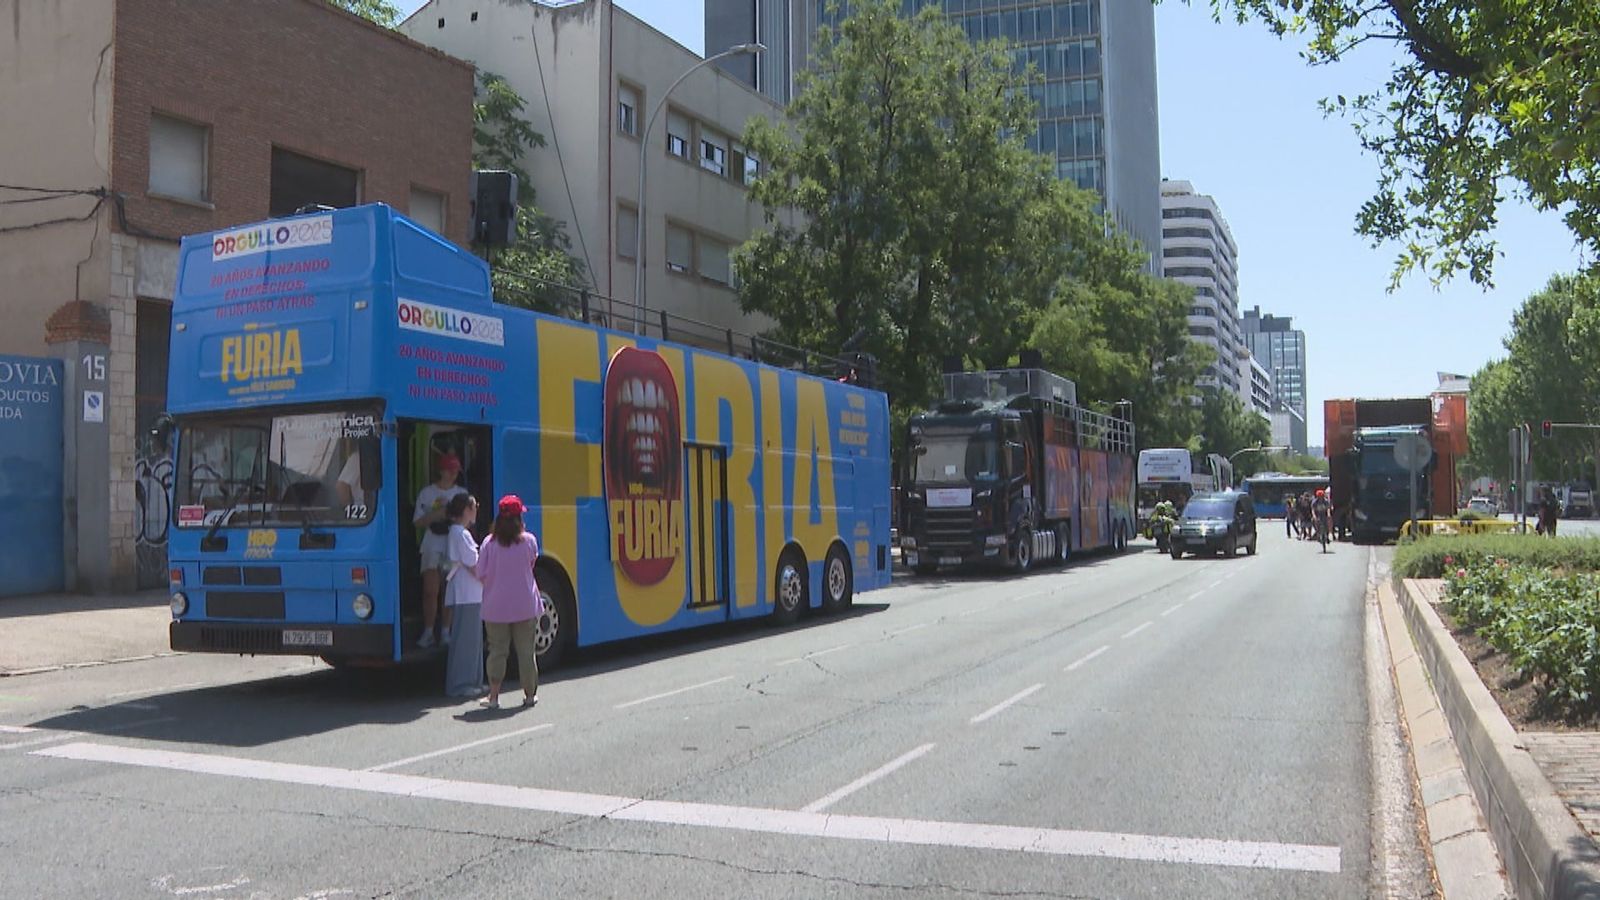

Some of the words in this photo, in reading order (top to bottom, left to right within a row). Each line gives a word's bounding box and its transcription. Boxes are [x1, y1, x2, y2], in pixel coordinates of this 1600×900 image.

[213, 220, 332, 256] ORGULLO2025
[255, 257, 330, 277] AVANZANDO
[224, 288, 239, 301] EN
[216, 305, 226, 319] NI
[228, 302, 244, 318] UN
[245, 299, 273, 314] PASO
[398, 303, 503, 340] ORGULLO2025
[221, 328, 303, 383] FURIA
[399, 343, 412, 358] 20
[414, 345, 443, 362] AÑOS
[446, 351, 505, 372] AVANZANDO
[82, 354, 105, 380] 15
[416, 366, 432, 379] EN
[408, 383, 420, 398] NI
[423, 386, 440, 400] UN
[440, 387, 465, 402] PASO
[344, 427, 371, 439] Projec
[344, 504, 368, 519] 122
[248, 529, 278, 547] HBO
[609, 499, 682, 562] FURIA
